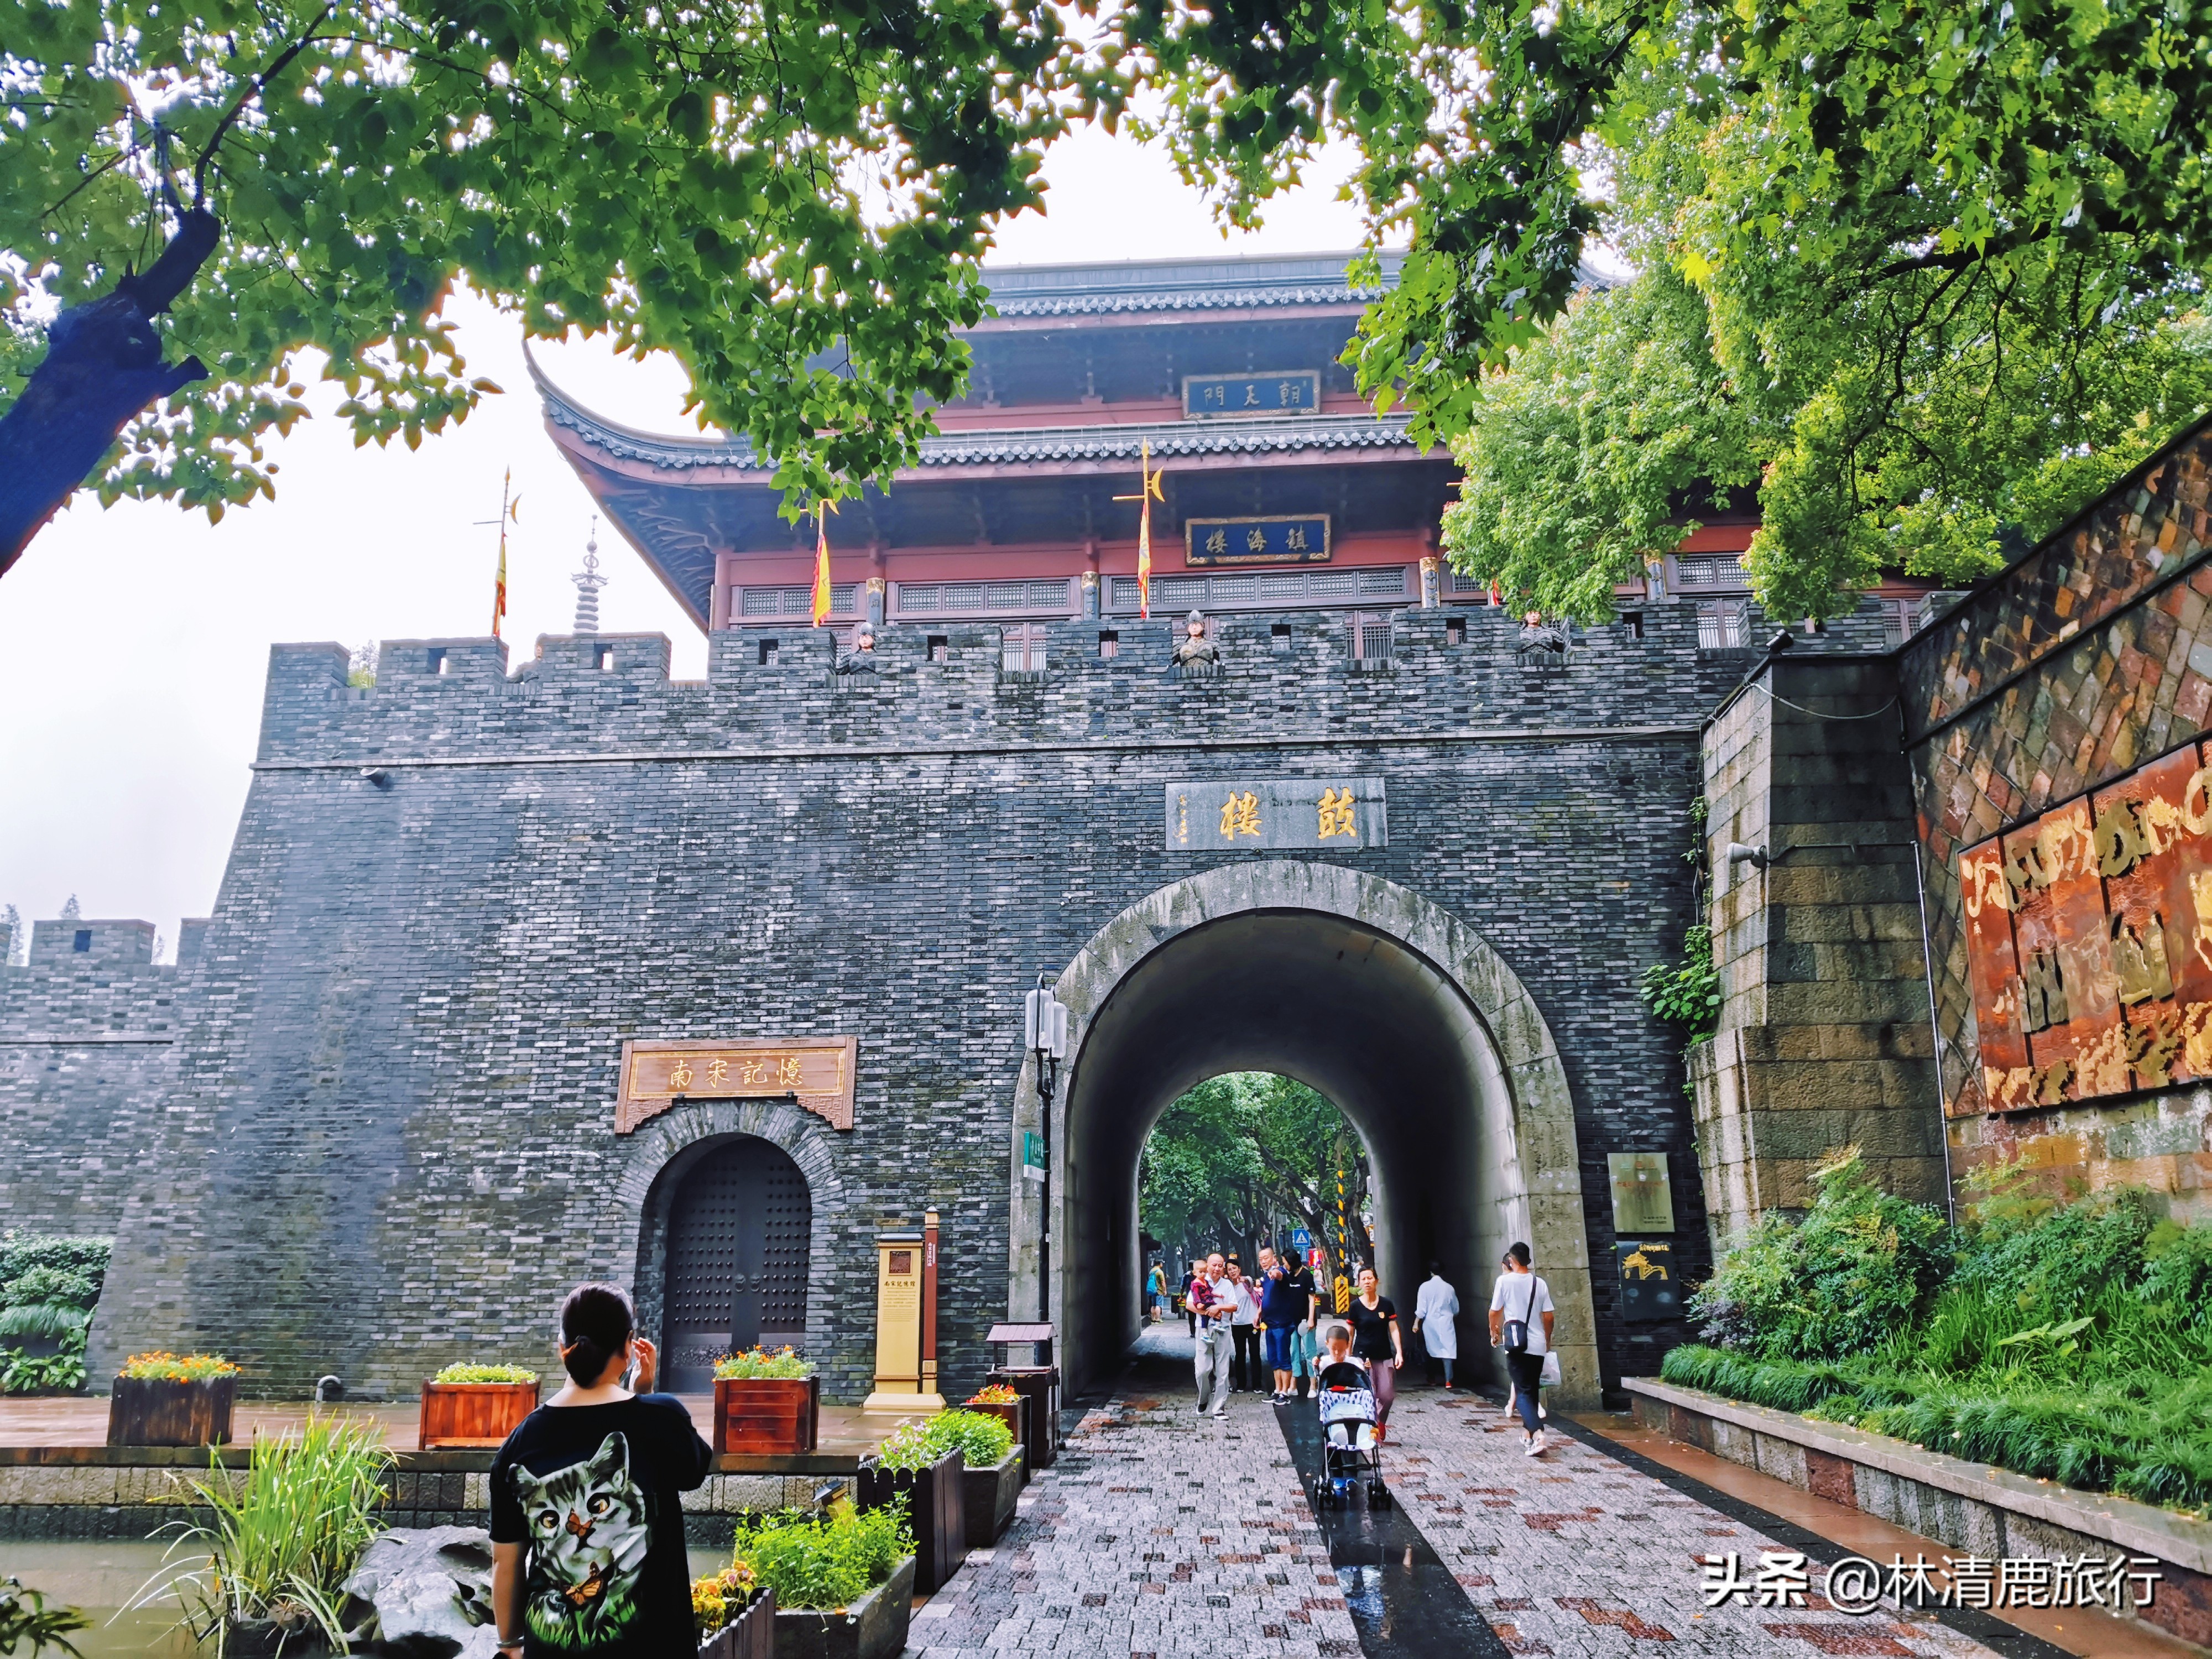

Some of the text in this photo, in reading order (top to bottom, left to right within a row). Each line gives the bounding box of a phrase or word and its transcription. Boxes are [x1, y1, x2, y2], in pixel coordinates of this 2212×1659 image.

[1219, 787, 1357, 841] 鼓樓
[671, 1058, 803, 1088] 南宋記憶
